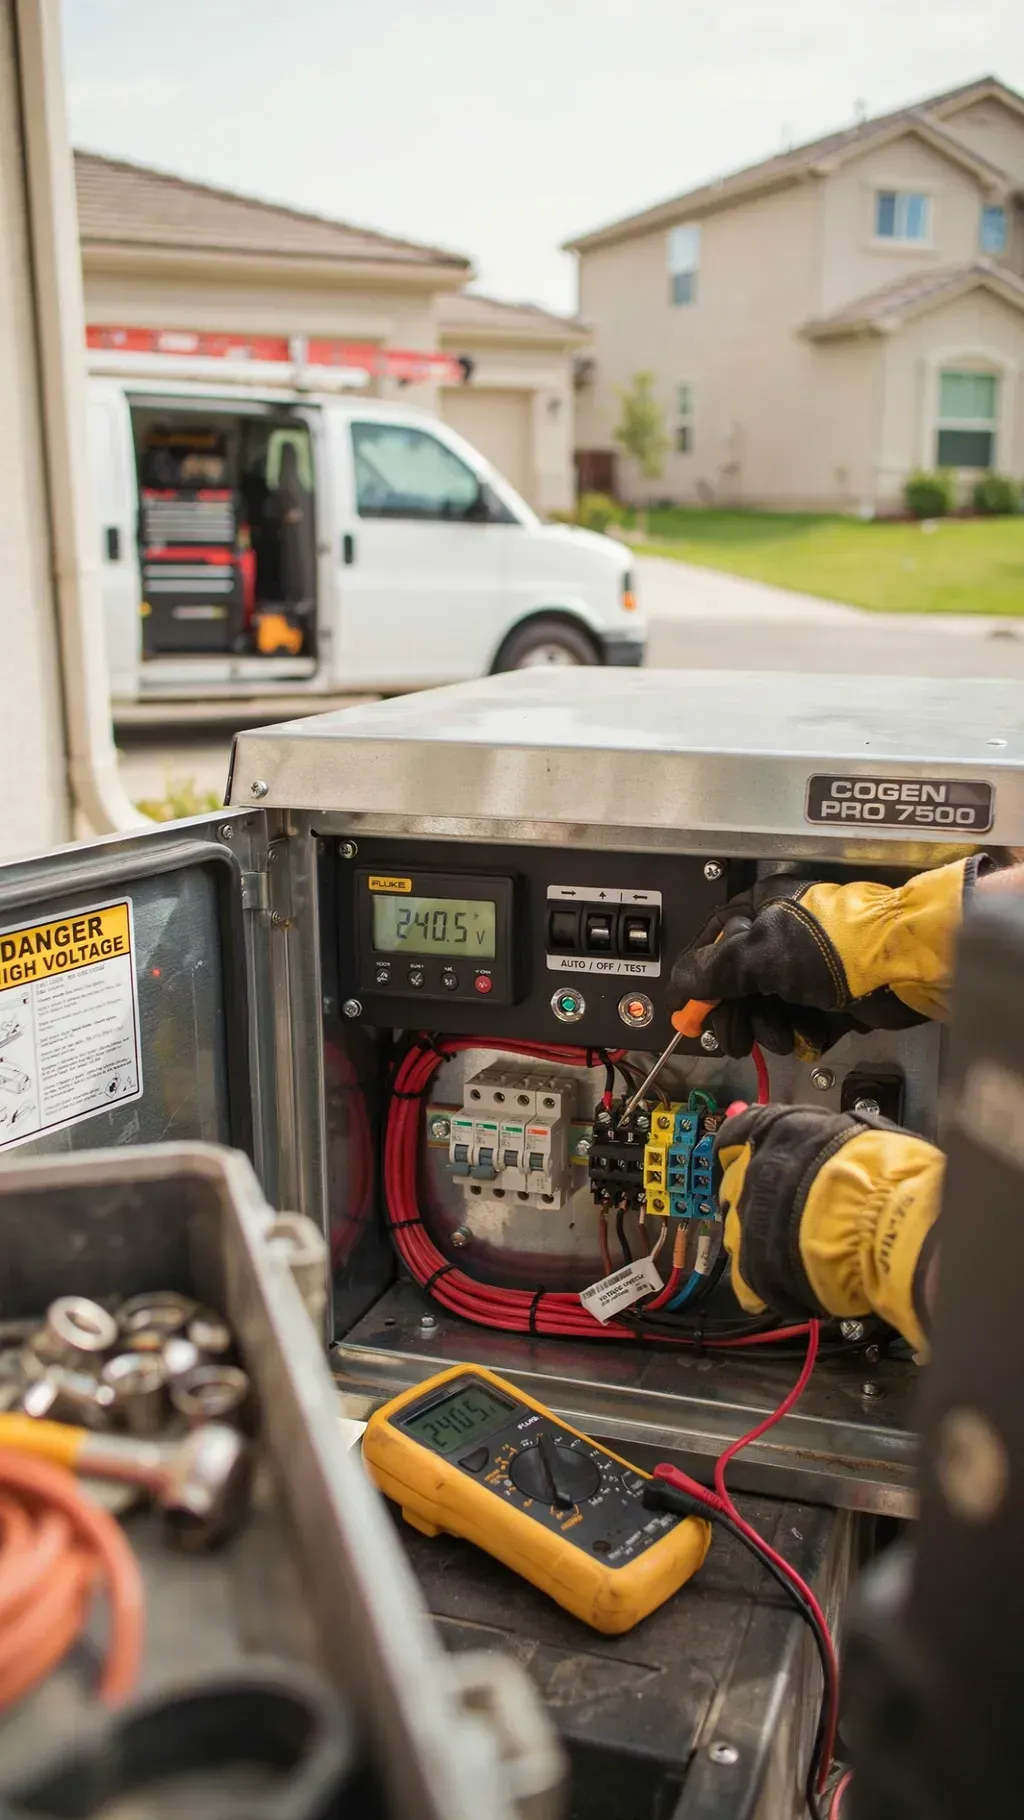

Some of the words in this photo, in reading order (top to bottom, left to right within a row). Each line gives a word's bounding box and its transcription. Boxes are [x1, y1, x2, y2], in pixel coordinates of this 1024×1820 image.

[830, 781, 946, 803] COGEN
[821, 800, 885, 820] PRO
[895, 804, 976, 825] 7500
[371, 879, 406, 889] FLUKE
[396, 908, 468, 943] 240.5
[0, 916, 104, 963] DANGER
[0, 959, 37, 985] IGH
[42, 935, 124, 971] VOLTAGE
[560, 959, 586, 969] AUTO
[596, 961, 615, 971] OFF
[624, 963, 648, 973] TEST
